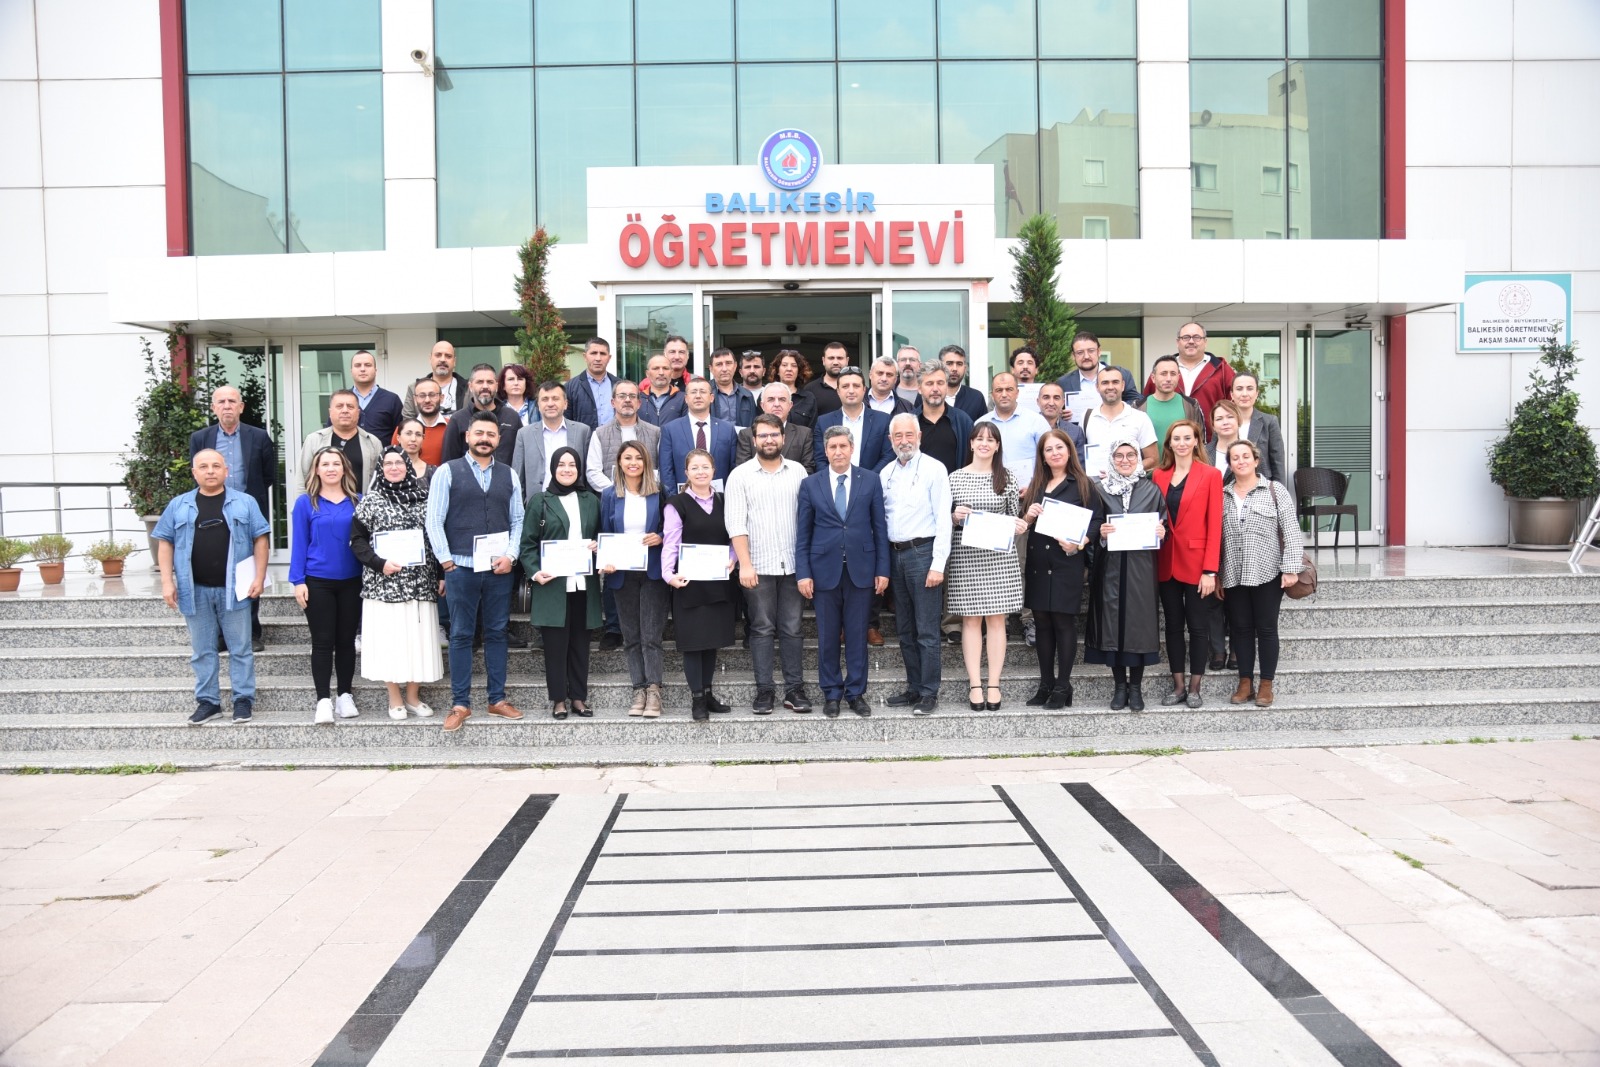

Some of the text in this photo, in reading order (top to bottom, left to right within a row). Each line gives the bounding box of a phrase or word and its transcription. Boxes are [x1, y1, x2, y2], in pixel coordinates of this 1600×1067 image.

[705, 188, 876, 213] BALIKESİR
[619, 210, 964, 268] ÖĞRETMENEVİ
[1467, 325, 1503, 333] BALIKESİR
